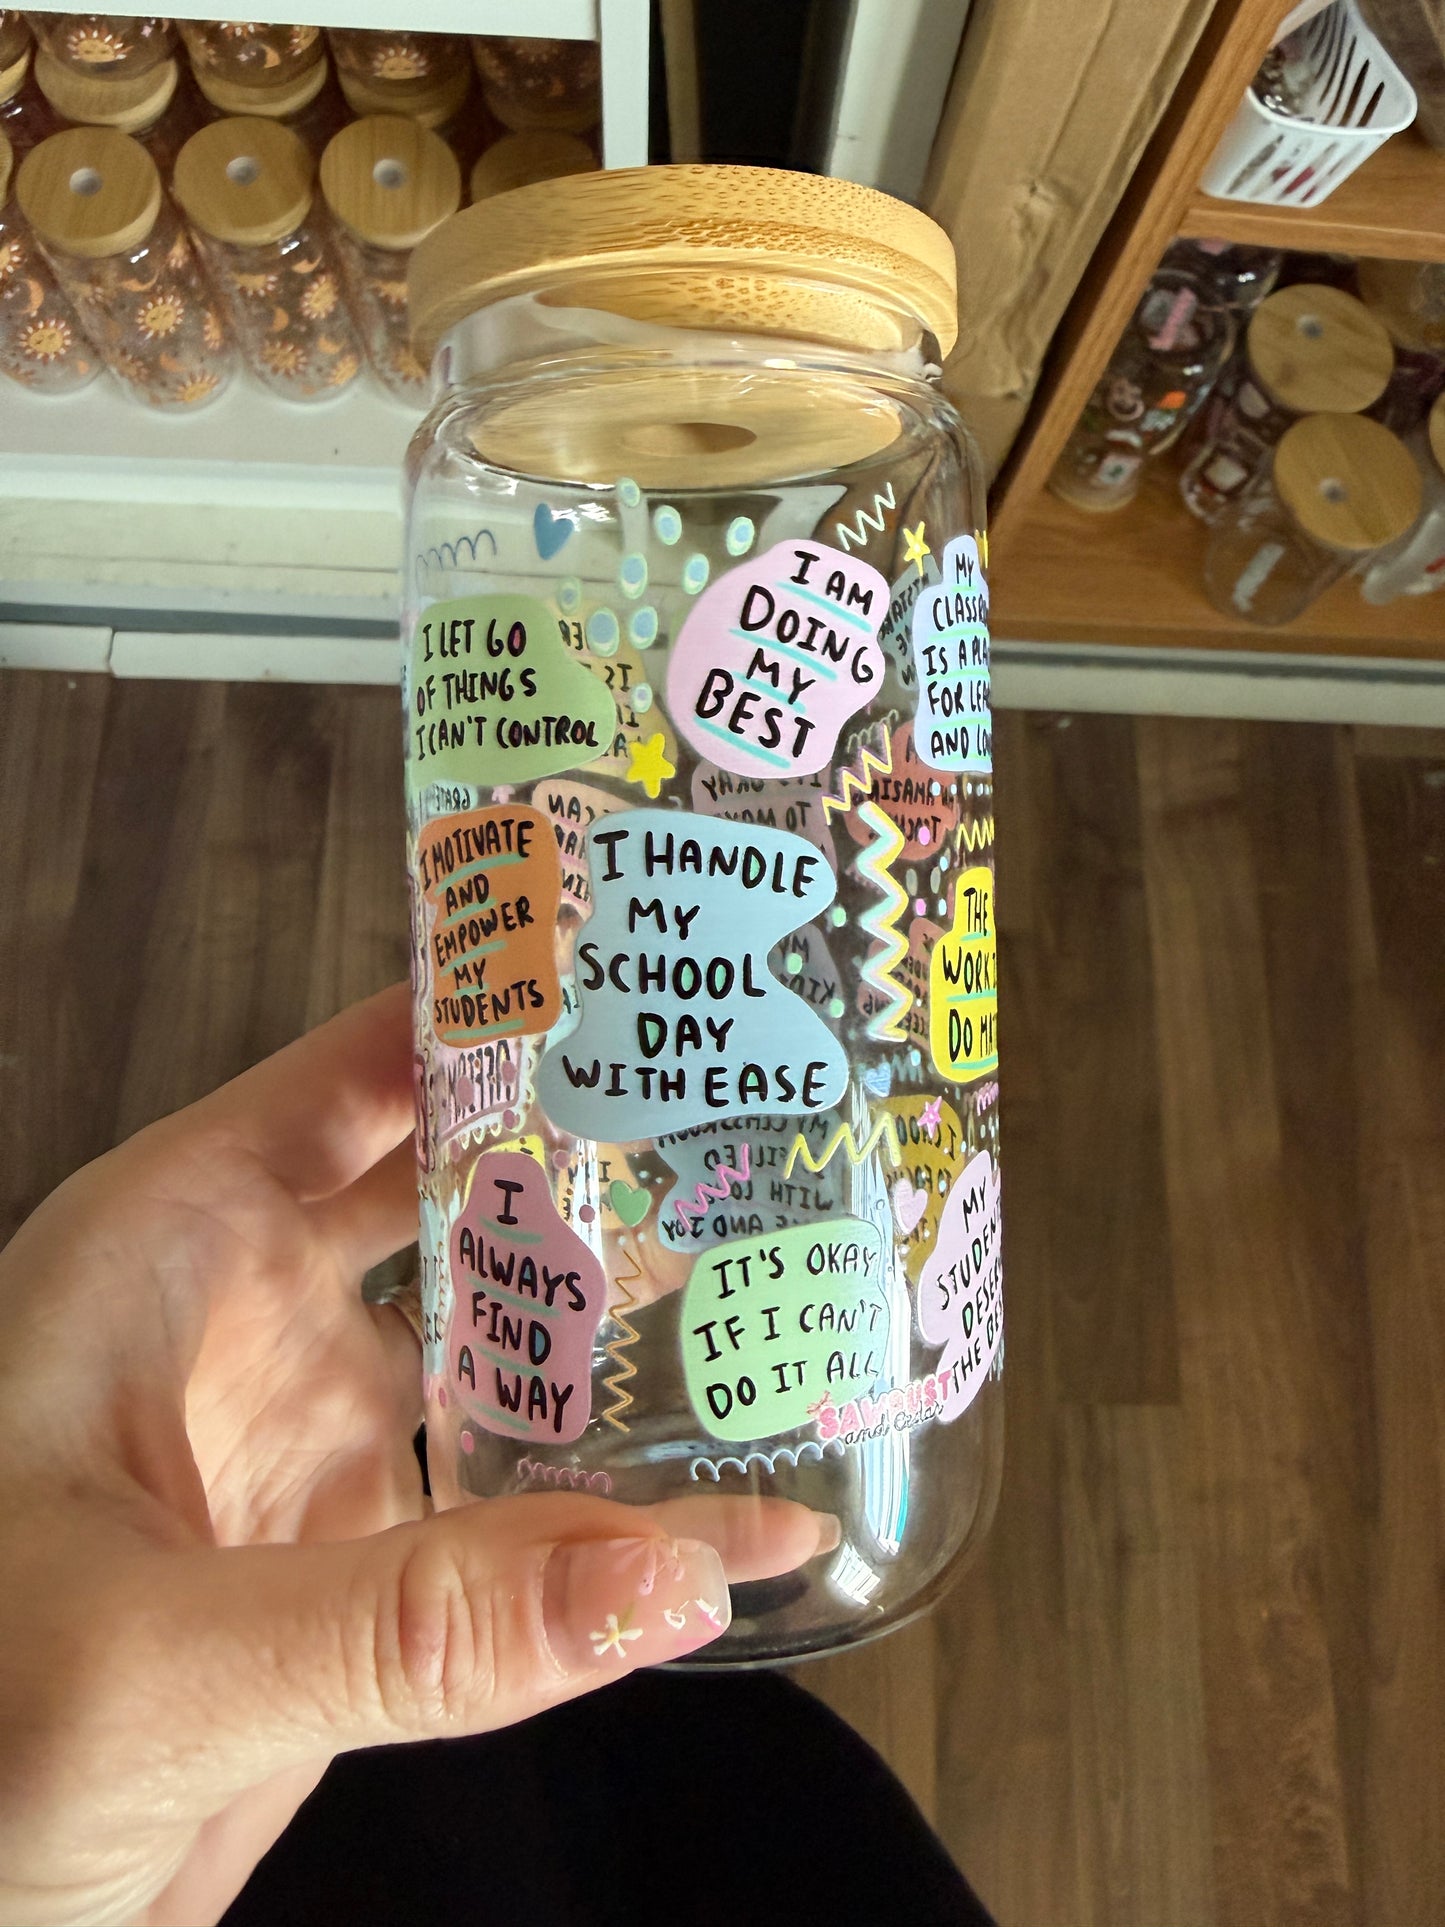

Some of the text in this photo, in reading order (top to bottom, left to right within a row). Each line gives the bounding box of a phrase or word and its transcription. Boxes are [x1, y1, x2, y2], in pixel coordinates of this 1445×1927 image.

[790, 550, 820, 585] I
[825, 570, 874, 616] AM
[956, 553, 974, 587] MY
[738, 584, 874, 683] DOING
[933, 592, 989, 632] CLASSR
[423, 623, 433, 662] I
[441, 620, 476, 658] LET
[486, 619, 527, 657] GO
[922, 645, 948, 676] IS
[959, 639, 967, 670] A
[972, 635, 989, 666] PLA
[417, 667, 538, 716] OF THINGS
[745, 647, 816, 705] MY
[927, 680, 964, 717] FOR
[416, 725, 426, 761] I
[428, 715, 487, 756] CAN'T
[496, 714, 600, 749] CONTROL
[695, 667, 816, 758] BEST
[931, 726, 969, 759] AND
[419, 849, 431, 891] I
[433, 819, 535, 875] MOTIVATE
[593, 830, 629, 881] I
[645, 831, 819, 898] HANDLE
[445, 873, 490, 917] AND
[629, 897, 700, 940] MY
[963, 887, 988, 936] THE
[434, 896, 535, 967] EMPOWER
[453, 958, 486, 990] MY
[579, 942, 767, 1000] SCHOOL
[943, 945, 990, 994] WORK
[434, 979, 545, 1028] STUDENTS
[637, 1012, 734, 1058] DAY
[949, 1008, 973, 1062] DO
[562, 1055, 686, 1102] WITH
[704, 1061, 829, 1108] EASE
[494, 1179, 523, 1225] I
[963, 1176, 986, 1233] MY
[459, 1228, 586, 1311] ALWAYS
[712, 1243, 877, 1299] IT'S OKAY
[937, 1196, 1001, 1310] STUDENT
[473, 1291, 551, 1366] FIND
[693, 1300, 883, 1362] IF I CAN'T
[458, 1345, 574, 1433] A WAY
[706, 1351, 879, 1420] DO IT ALL
[952, 1337, 981, 1393] THE
